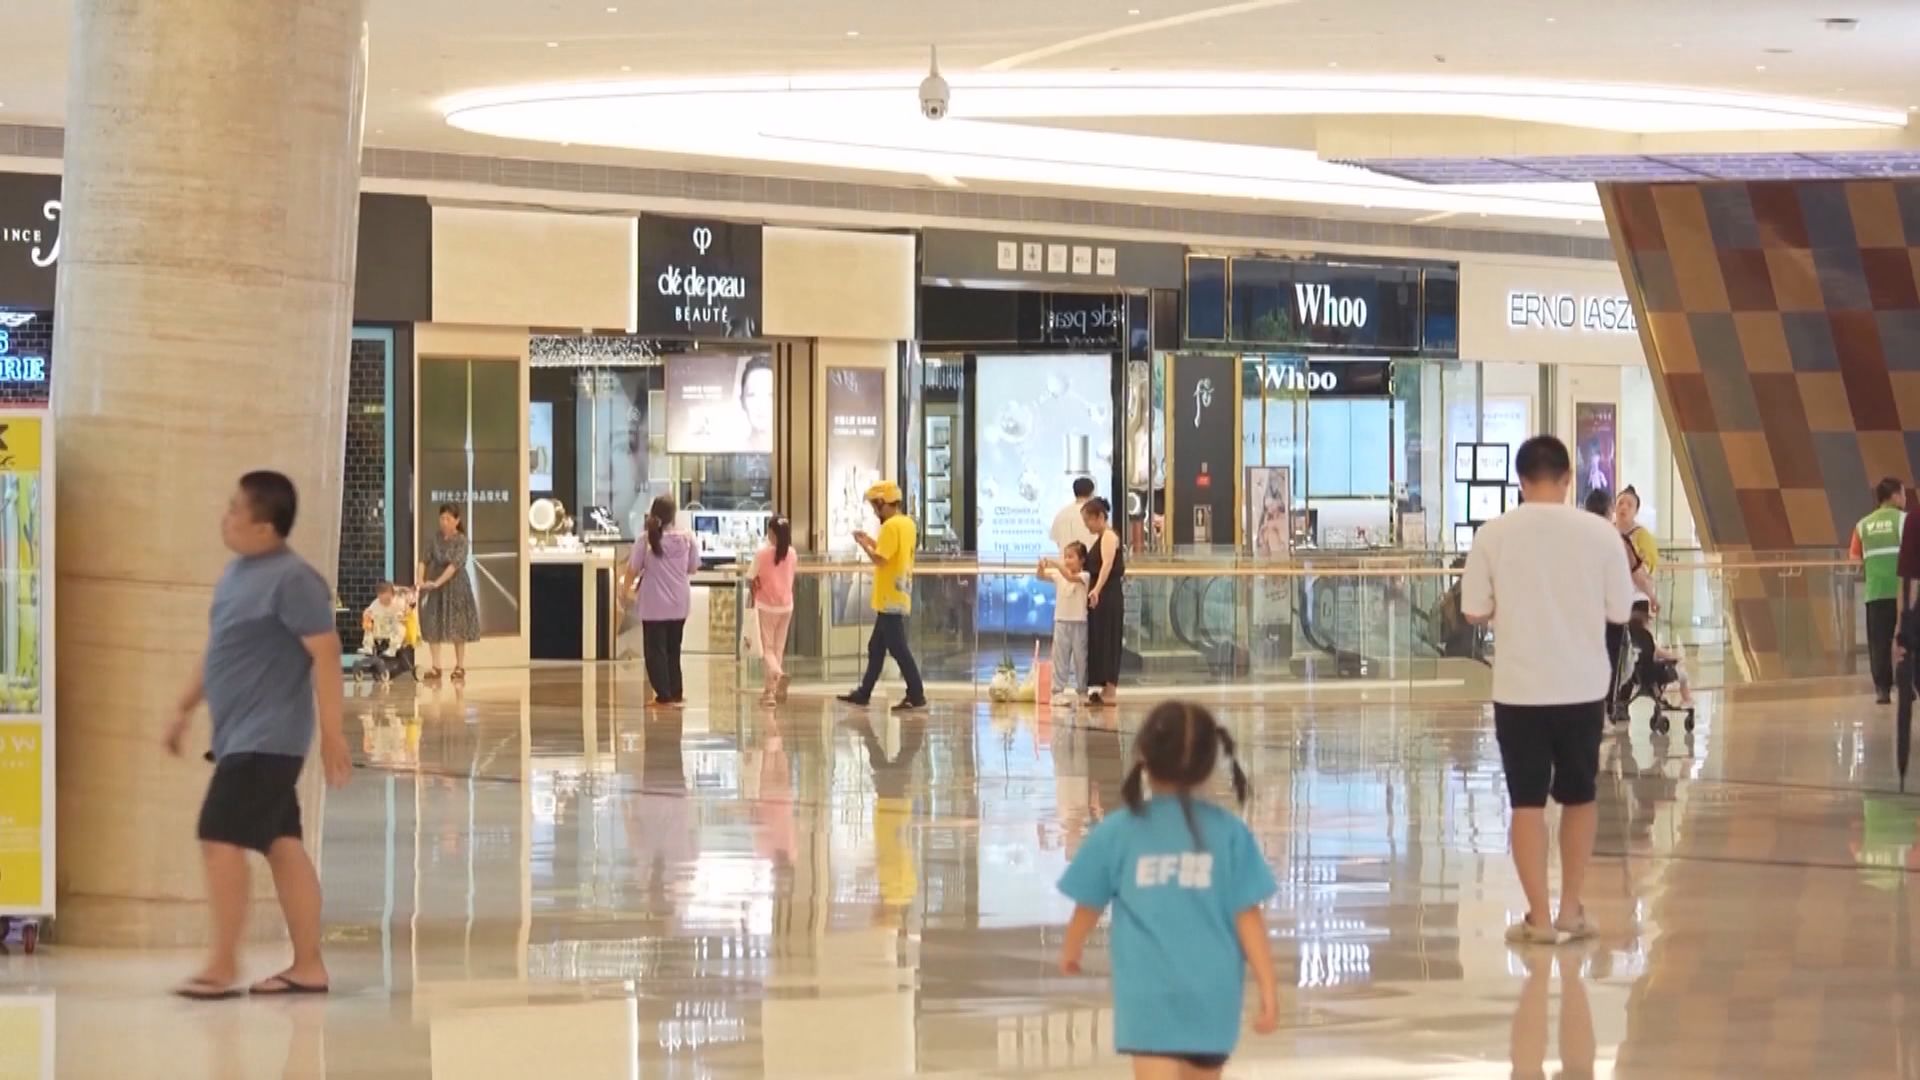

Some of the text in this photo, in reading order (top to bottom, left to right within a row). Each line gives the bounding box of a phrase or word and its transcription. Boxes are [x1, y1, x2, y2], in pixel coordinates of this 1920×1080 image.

[683, 265, 706, 297] de
[707, 275, 745, 306] peau
[675, 305, 729, 323] BEAUTÉ
[1295, 283, 1367, 328] Whoo
[1510, 293, 1576, 328] ERNO
[1256, 364, 1338, 391] Whoo
